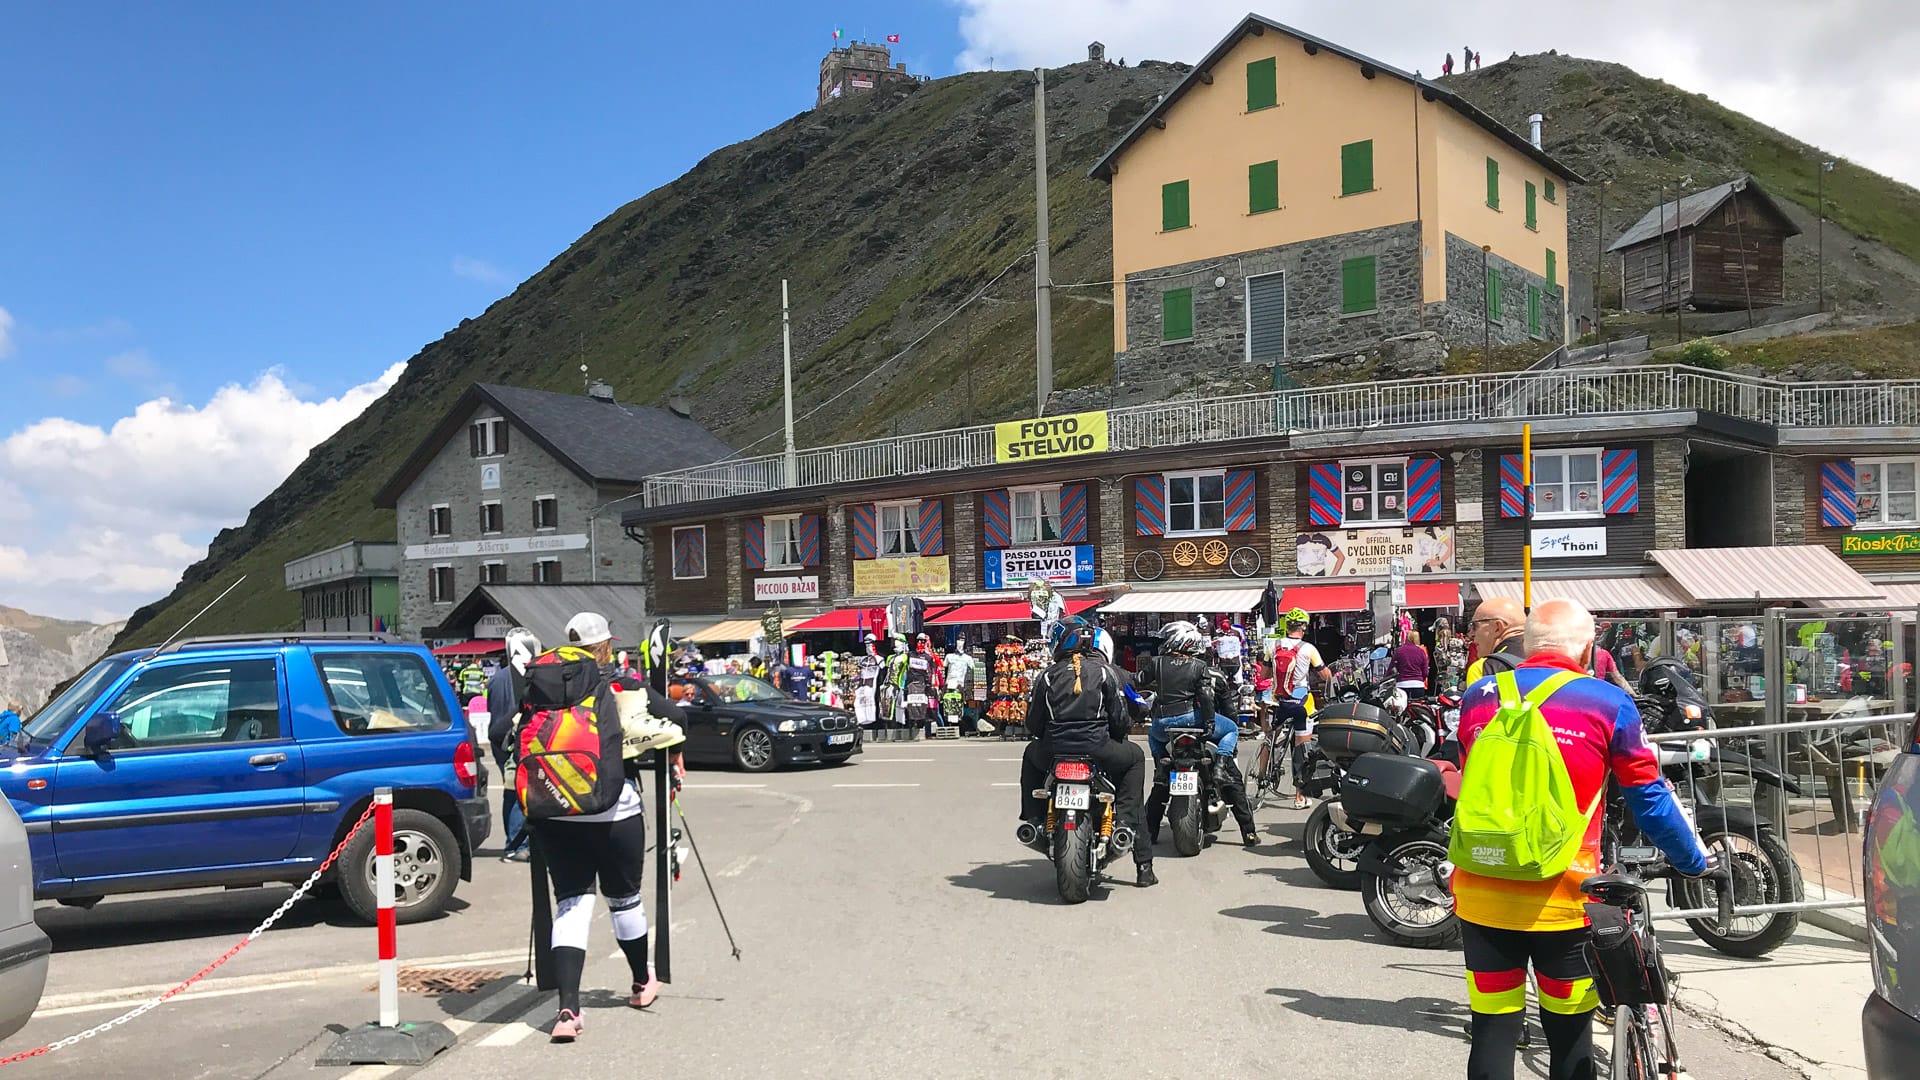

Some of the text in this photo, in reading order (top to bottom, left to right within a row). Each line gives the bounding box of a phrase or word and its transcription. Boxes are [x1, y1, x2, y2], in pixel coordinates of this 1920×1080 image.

[1021, 418, 1078, 439] FOTO
[1008, 434, 1094, 458] STELVIO
[1366, 536, 1392, 544] OFFICIAL
[1540, 533, 1598, 551] Sport Thöni
[1845, 536, 1892, 551] Kiosk
[1005, 549, 1072, 559] PASSO DELLO
[1347, 544, 1413, 556] CYCLING GEAR
[1006, 558, 1072, 572] STELVIO
[1357, 557, 1377, 565] PASSO
[757, 582, 816, 594] PICCOLO BAZAR
[1059, 785, 1070, 795] 1A
[1171, 782, 1193, 790] 6580
[1057, 796, 1083, 807] 8940
[1472, 847, 1506, 857] INPUT
